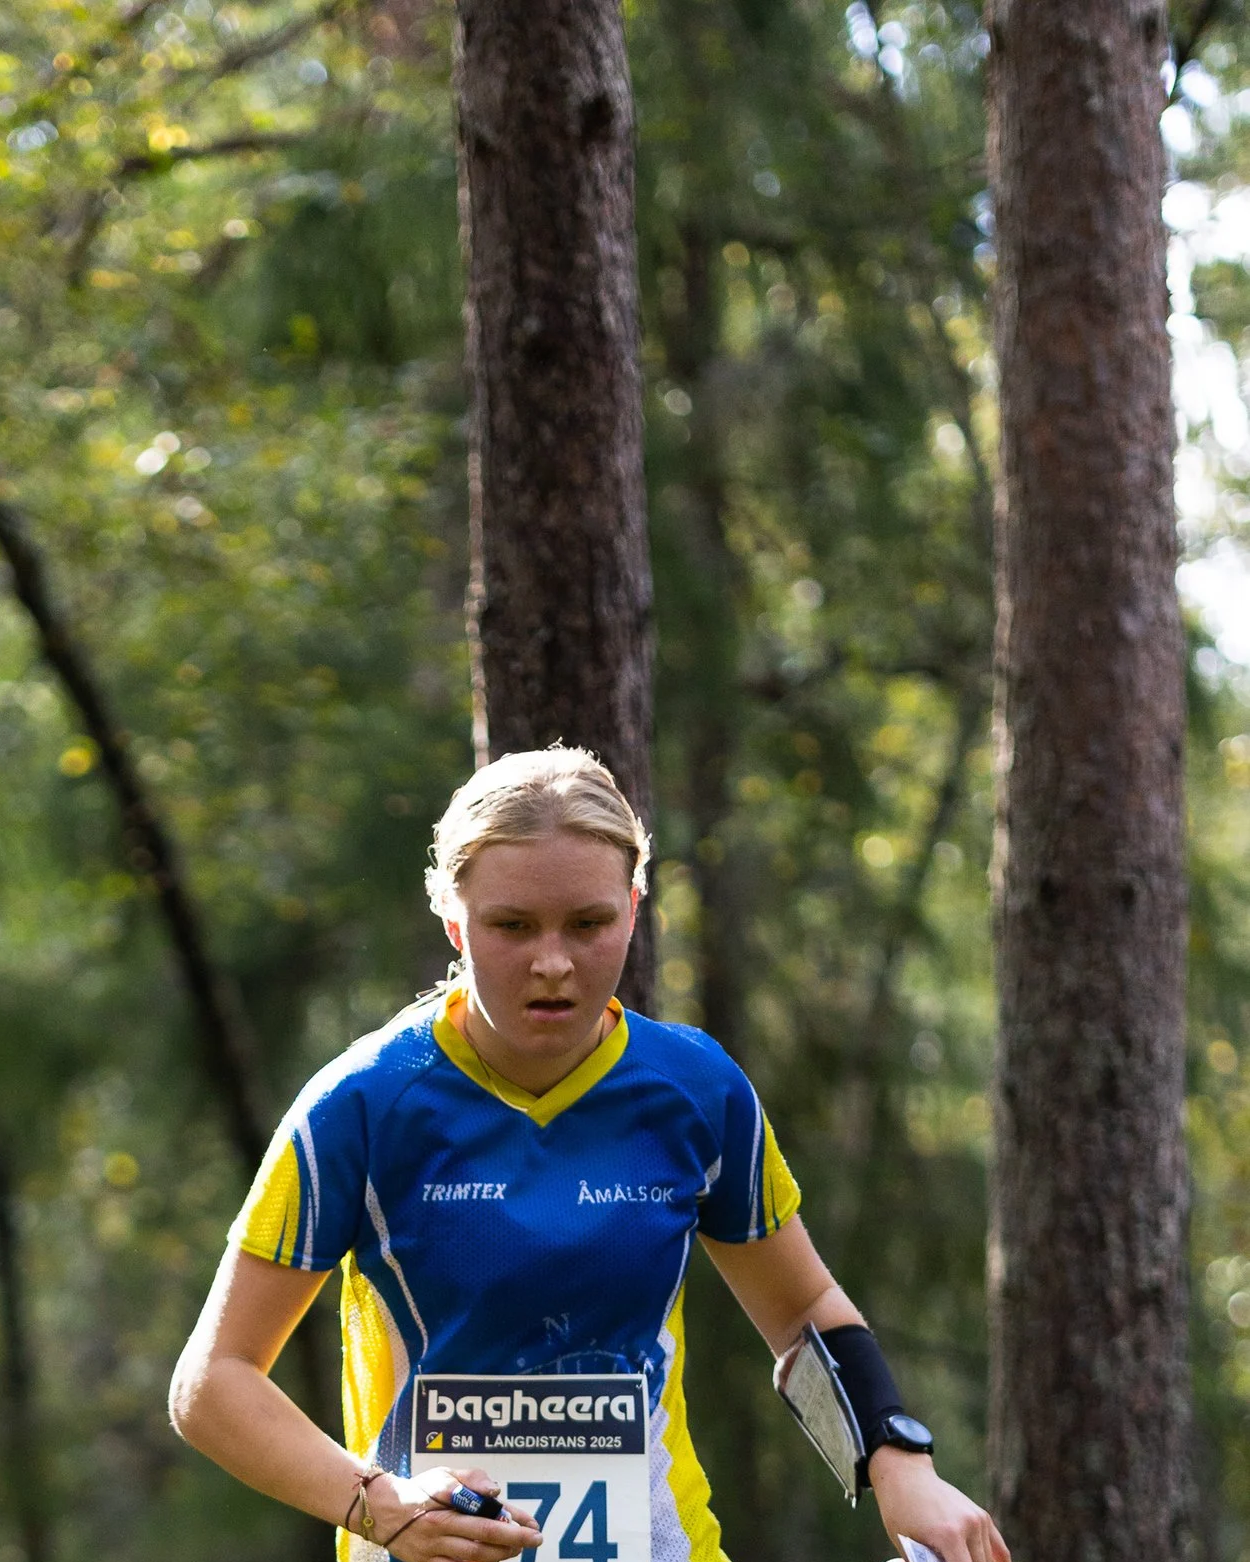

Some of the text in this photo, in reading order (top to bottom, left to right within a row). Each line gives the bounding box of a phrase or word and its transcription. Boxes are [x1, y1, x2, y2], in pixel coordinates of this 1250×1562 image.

[422, 1183, 507, 1201] TRIMTEX
[427, 1389, 636, 1427] bagheera
[451, 1433, 623, 1448] SM LÅNGDISTANS 2025
